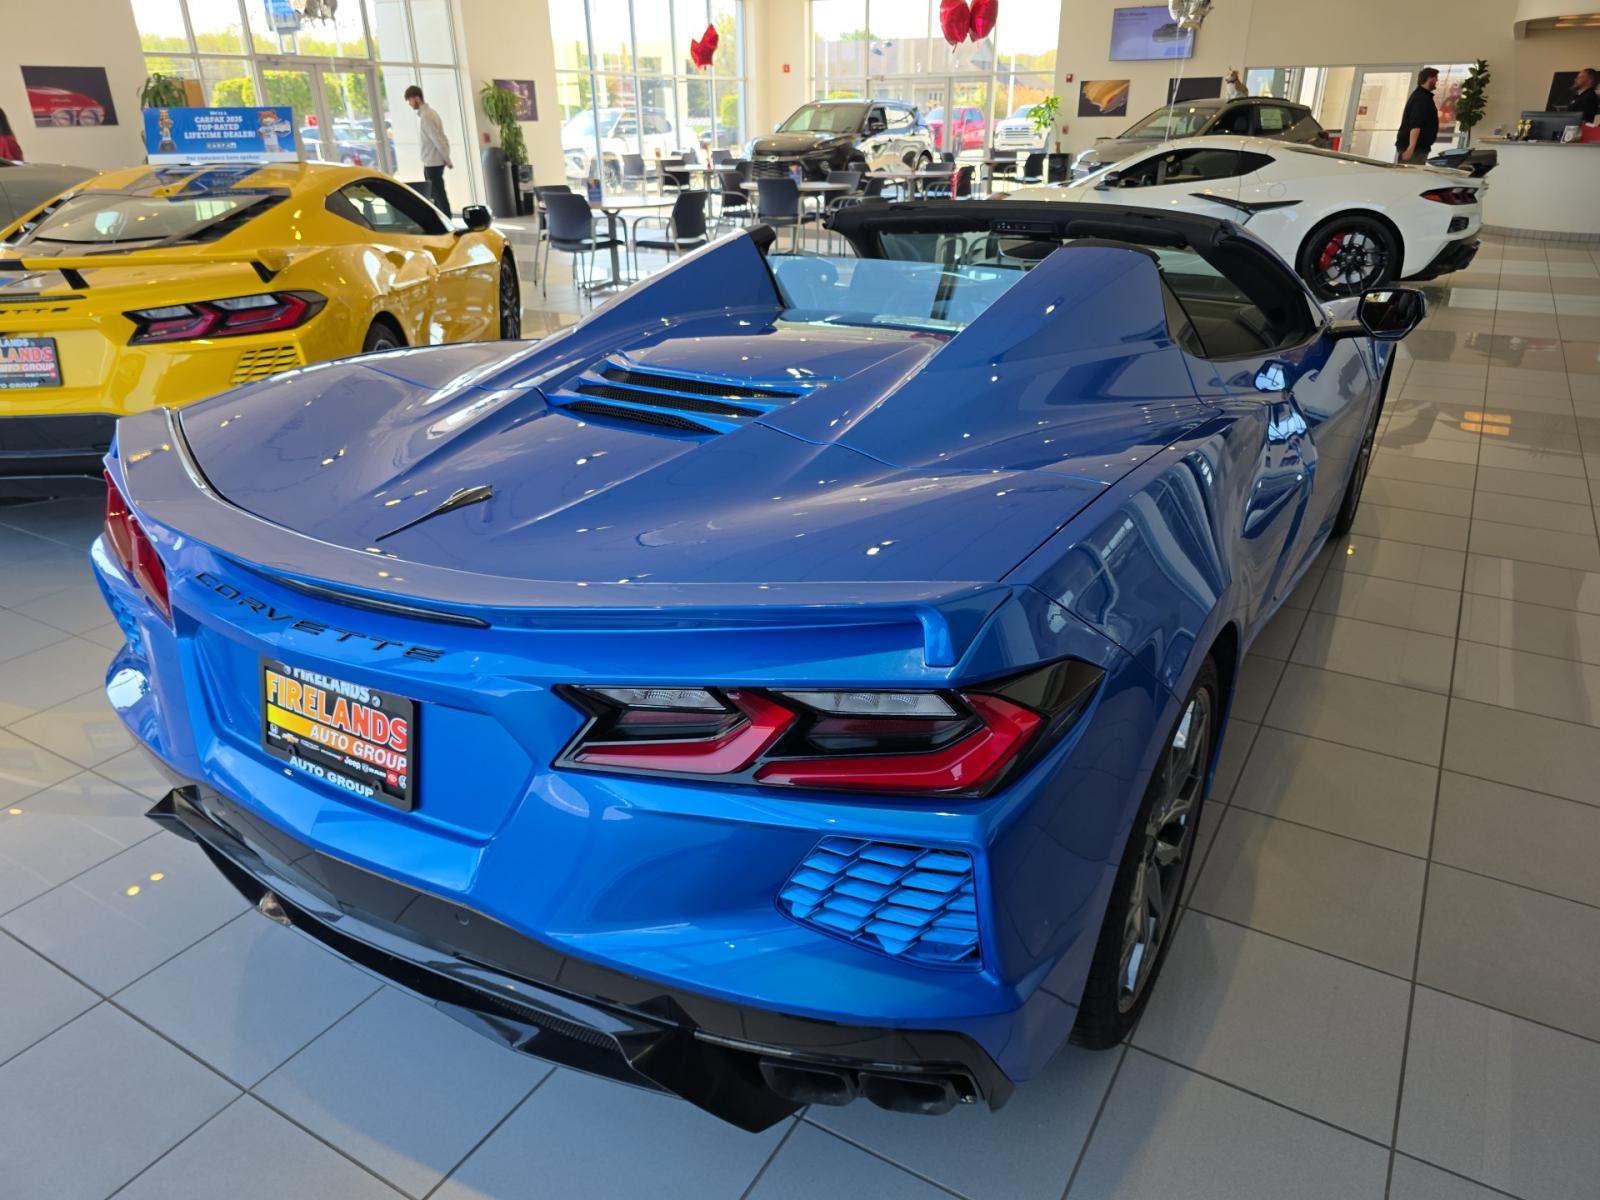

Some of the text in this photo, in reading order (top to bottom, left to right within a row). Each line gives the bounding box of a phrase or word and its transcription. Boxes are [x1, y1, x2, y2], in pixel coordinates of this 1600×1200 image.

[196, 123, 240, 131] TOP-RATED
[22, 362, 55, 372] GROUP
[195, 571, 447, 664] CORVETTE
[293, 667, 370, 703] FIRELANDS
[265, 668, 407, 753] FIRELANDS
[310, 725, 349, 750] AUTO
[352, 741, 407, 771] GROUP
[288, 755, 374, 797] AUTO GROUP
